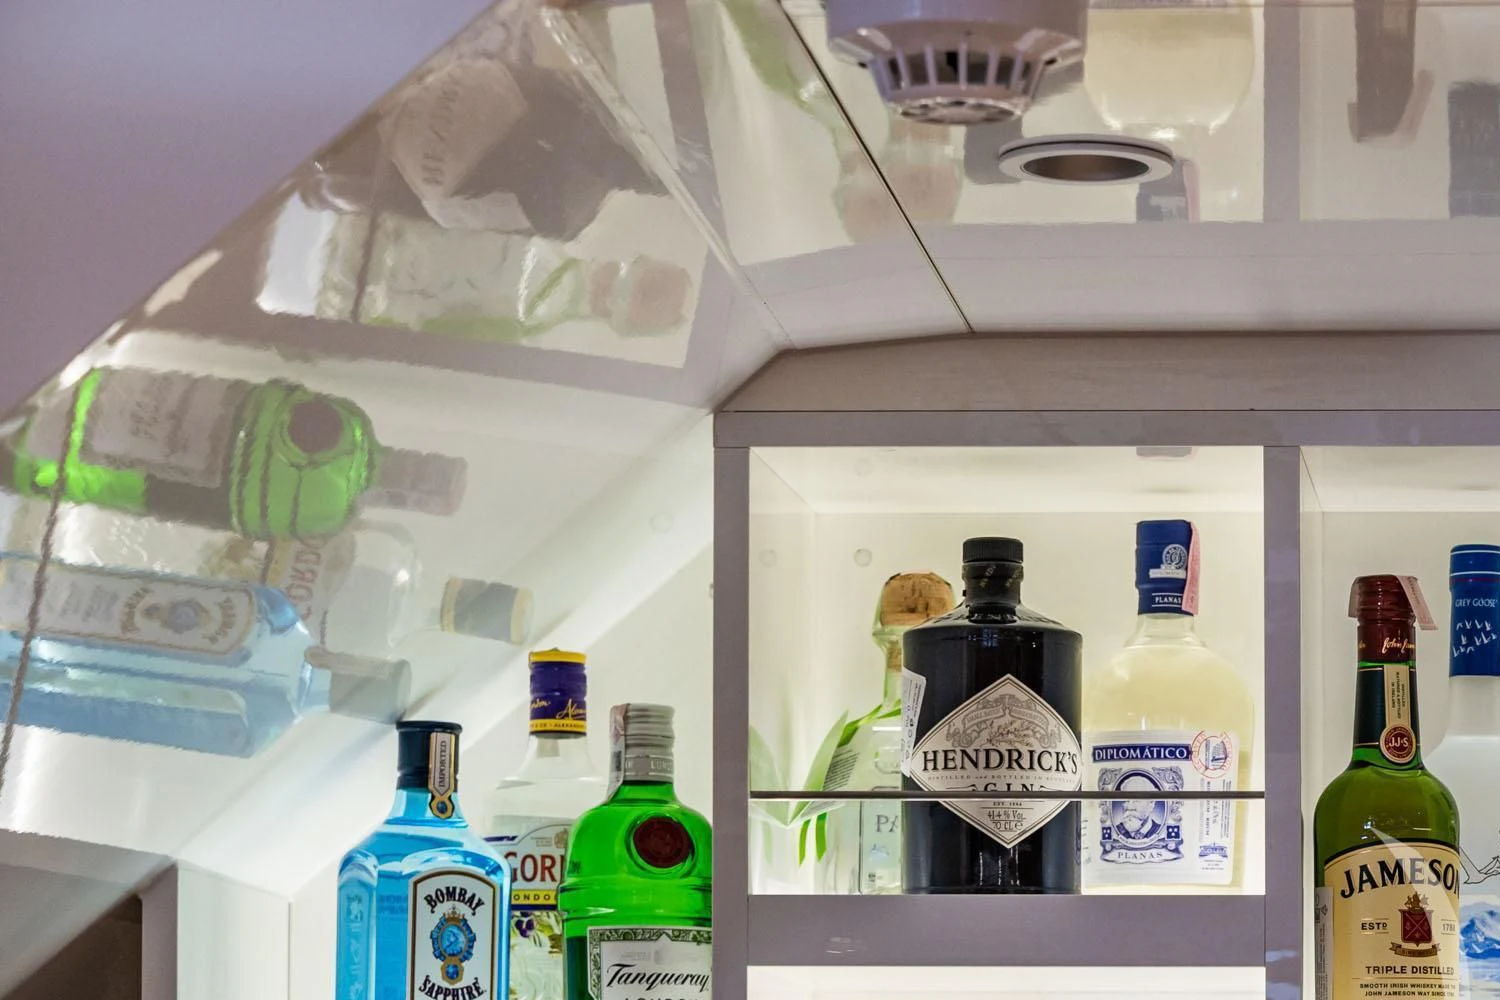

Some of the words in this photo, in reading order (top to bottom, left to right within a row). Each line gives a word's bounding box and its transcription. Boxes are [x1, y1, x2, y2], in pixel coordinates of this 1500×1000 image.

[922, 749, 1078, 775] HENDRICK'S
[1095, 745, 1188, 761] DIPLOMÁTICO
[438, 740, 448, 788] IMPORTED
[983, 782, 1034, 792] GIN
[1117, 852, 1163, 860] PLANAS
[504, 851, 565, 883] GOR
[424, 886, 485, 916] BOMBAY
[512, 893, 557, 901] ONDO
[606, 963, 710, 992] Tanqueray
[1365, 966, 1408, 974] TRIPLE
[1411, 966, 1455, 975] DISTILLED
